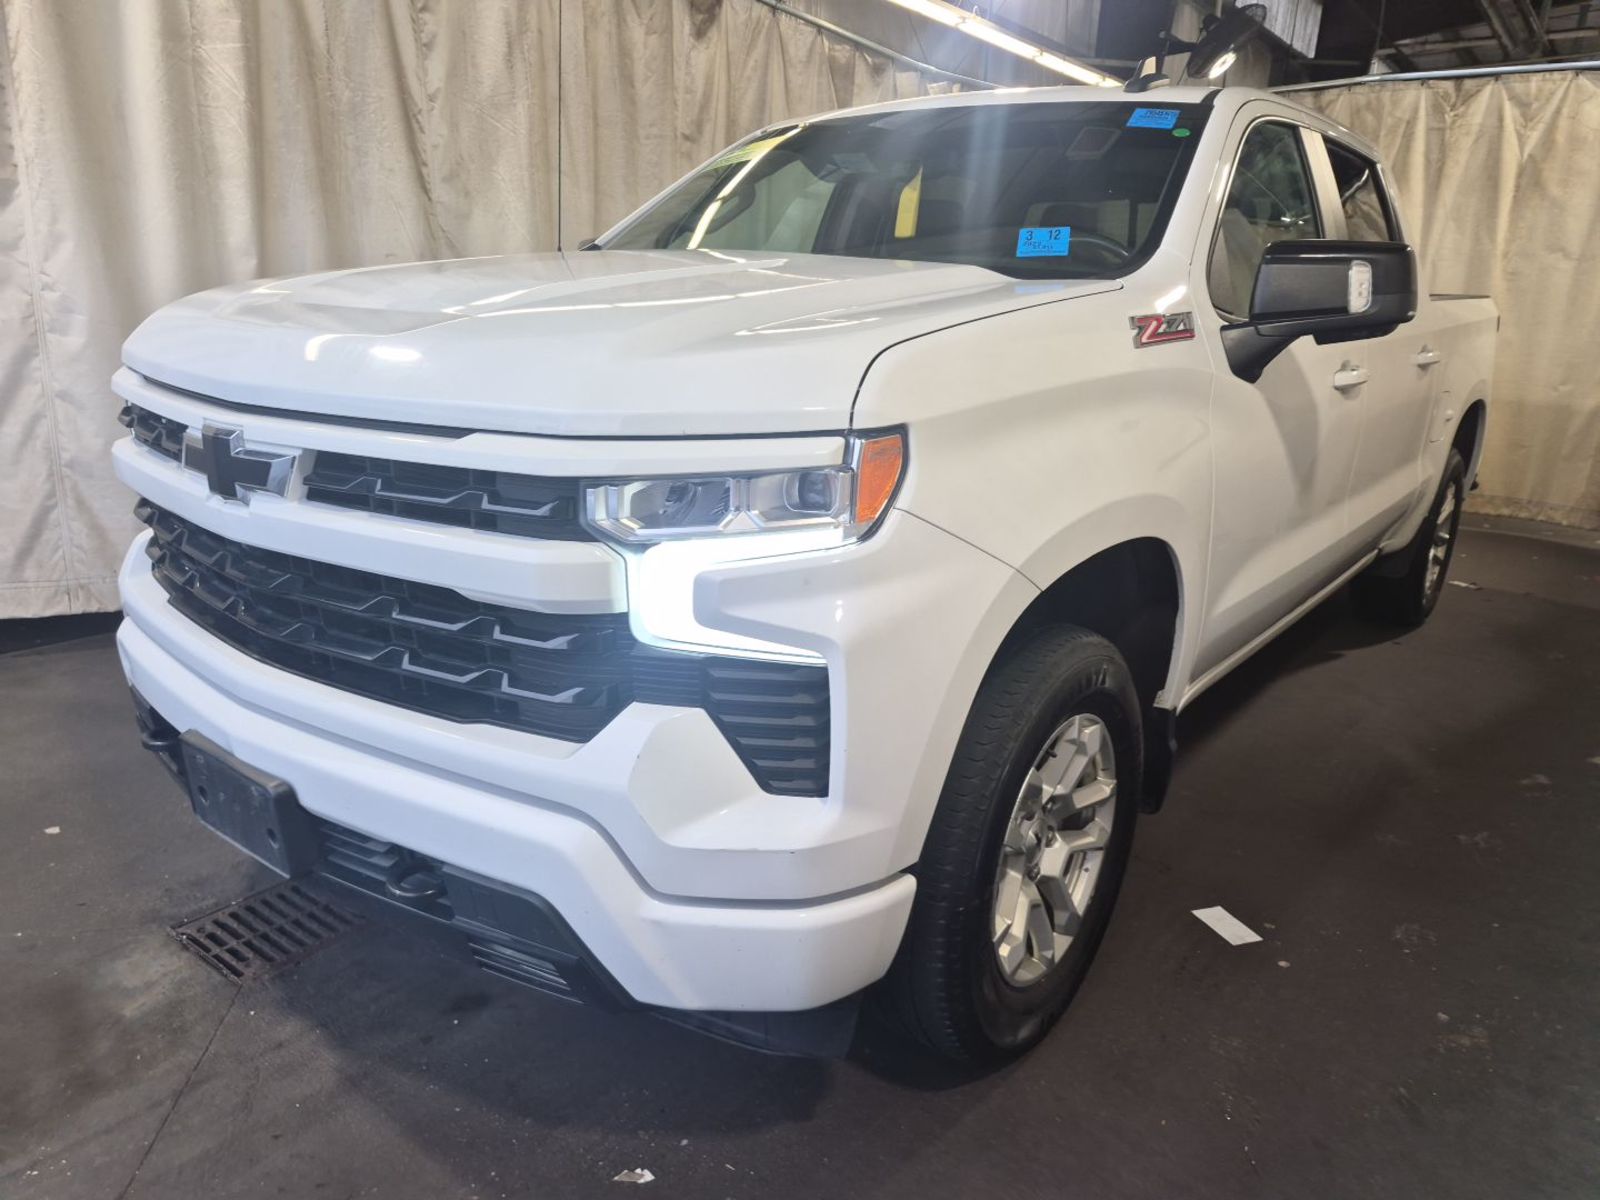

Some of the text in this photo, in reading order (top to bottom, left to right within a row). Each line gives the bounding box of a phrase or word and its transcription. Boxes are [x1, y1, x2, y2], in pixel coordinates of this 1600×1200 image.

[1026, 229, 1061, 241] 3 12
[1129, 311, 1195, 348] Z71
